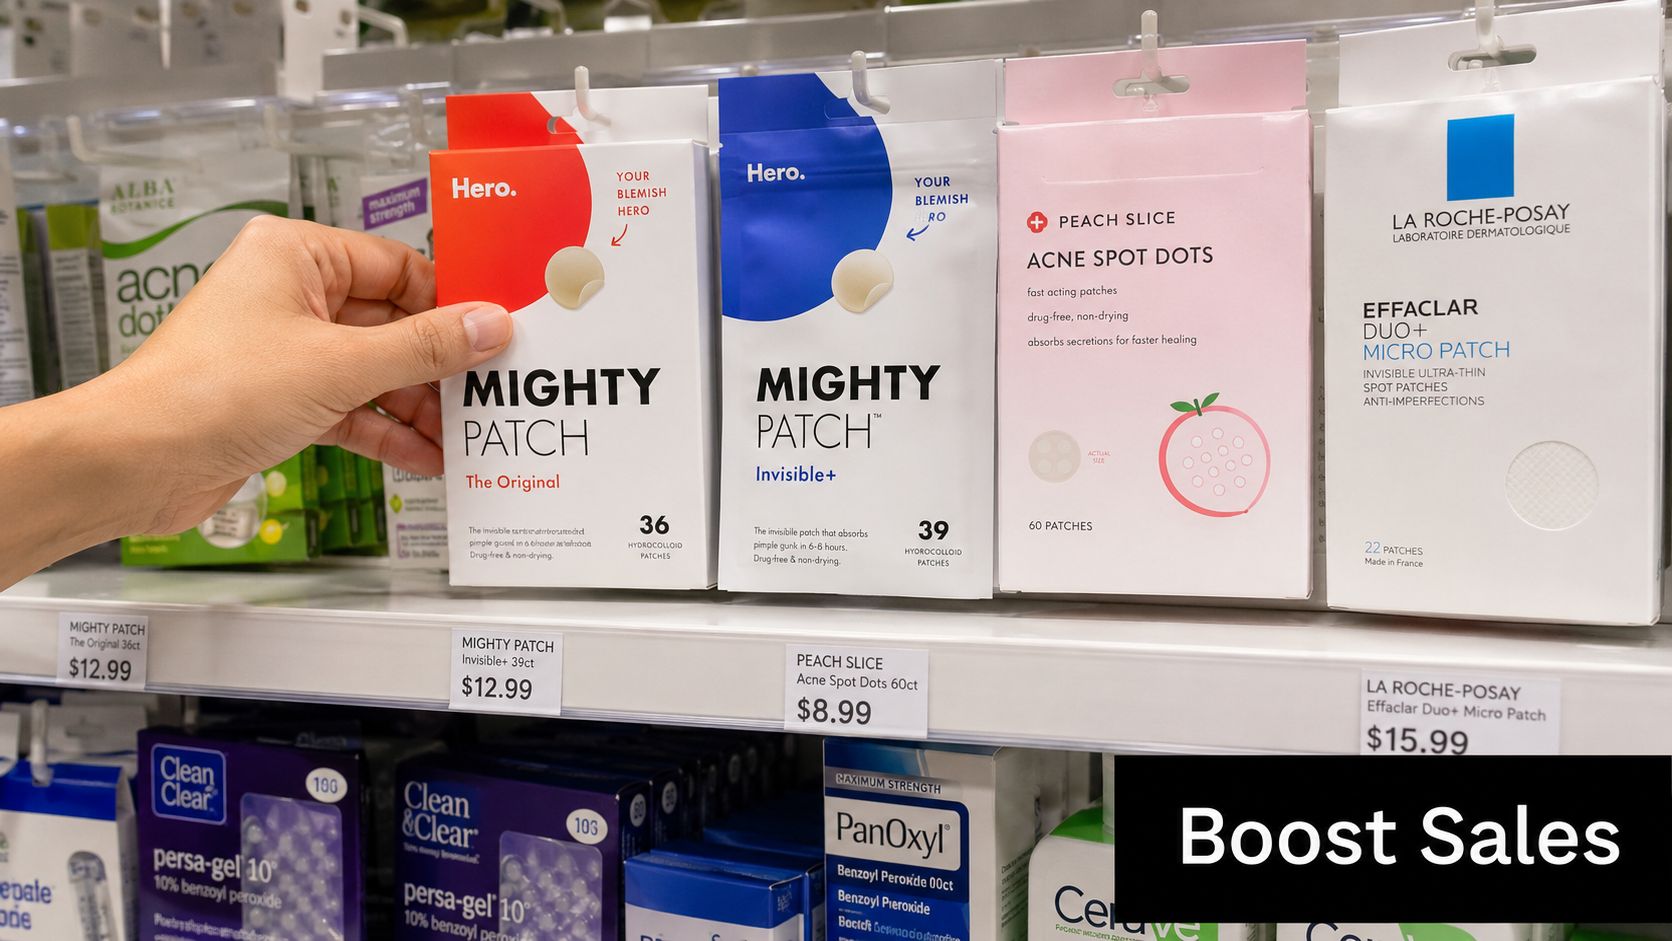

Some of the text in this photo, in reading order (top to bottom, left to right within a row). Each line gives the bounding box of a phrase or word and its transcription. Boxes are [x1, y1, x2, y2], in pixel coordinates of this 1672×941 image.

[616, 171, 649, 182] YOUR
[747, 163, 805, 183] Hero.
[914, 176, 951, 188] YOUR
[451, 177, 517, 199] Hero.
[617, 188, 667, 199] BLEMISH
[915, 193, 969, 206] BLEMISH
[369, 201, 415, 224] strength
[618, 206, 650, 216] HERO
[1059, 211, 1176, 228] PEACH SLICE
[1392, 203, 1571, 230] LA ROCHE-POSAY
[1392, 223, 1571, 243] LABORATOIRE DERMATOLOGIQUE
[1027, 246, 1214, 269] ACNE SPOT DOTS
[117, 261, 215, 303] acn
[1027, 286, 1118, 298] fast acting patches
[1027, 311, 1129, 324] drug-free, non-drying
[1363, 298, 1479, 319] EFFACLAR
[1363, 321, 1427, 340] DUO+
[1027, 335, 1197, 347] absorbs secretions for faster healing
[1363, 340, 1510, 361] MICRO PATCH
[1363, 367, 1486, 379] INVISIBLE ULTRA-THIN
[463, 368, 661, 407] MIGHTY
[756, 365, 942, 402] MIGHTY
[1363, 382, 1448, 393] SPOT PATCHES
[1363, 396, 1485, 407] ANTI-IMPERFECTIONS
[464, 419, 588, 456] PATCH
[466, 474, 560, 492] The Original
[755, 465, 837, 483] Invisible+
[639, 515, 670, 534] 36
[754, 526, 767, 535] The
[799, 528, 820, 538] patch
[822, 529, 837, 537] that
[838, 529, 869, 538] absorbs
[918, 520, 950, 540] 39
[1028, 520, 1093, 532] 60 PATCHES
[753, 541, 778, 550] pimple
[780, 542, 798, 551] gunk
[824, 543, 848, 552] hours.
[904, 548, 962, 556] HYDROCOLLOID
[1364, 541, 1423, 556] 22 PATCHES
[790, 555, 796, 564] &
[917, 559, 950, 567] PATCHES
[1364, 557, 1423, 568] Made in France
[69, 621, 145, 636] MIGHTY PATCH
[69, 637, 141, 651] The Original 36ct
[462, 637, 554, 653] MIGHTY PATCH
[69, 657, 131, 681] $12.99
[462, 654, 535, 668] Invisible+ 39ct
[797, 653, 883, 670] PEACH SLICE
[462, 675, 532, 700] $12.99
[796, 673, 918, 690] Acne Spot Dots 60ct
[1367, 679, 1522, 701] LA ROCHE-POSAY
[797, 697, 872, 725] $8.99
[1367, 700, 1546, 722] Effaclar Duo+ Micro Patch
[1367, 724, 1469, 755] $15.99
[160, 755, 215, 785] Clean
[888, 780, 942, 794] STRENGTH
[404, 781, 470, 819] Clean
[837, 864, 878, 883] Benzoyl
[154, 875, 282, 909] 10% benzoyl peroxide
[838, 889, 880, 909] Benzoyl
[404, 909, 429, 928] 10%
[431, 915, 478, 941] benzoyl
